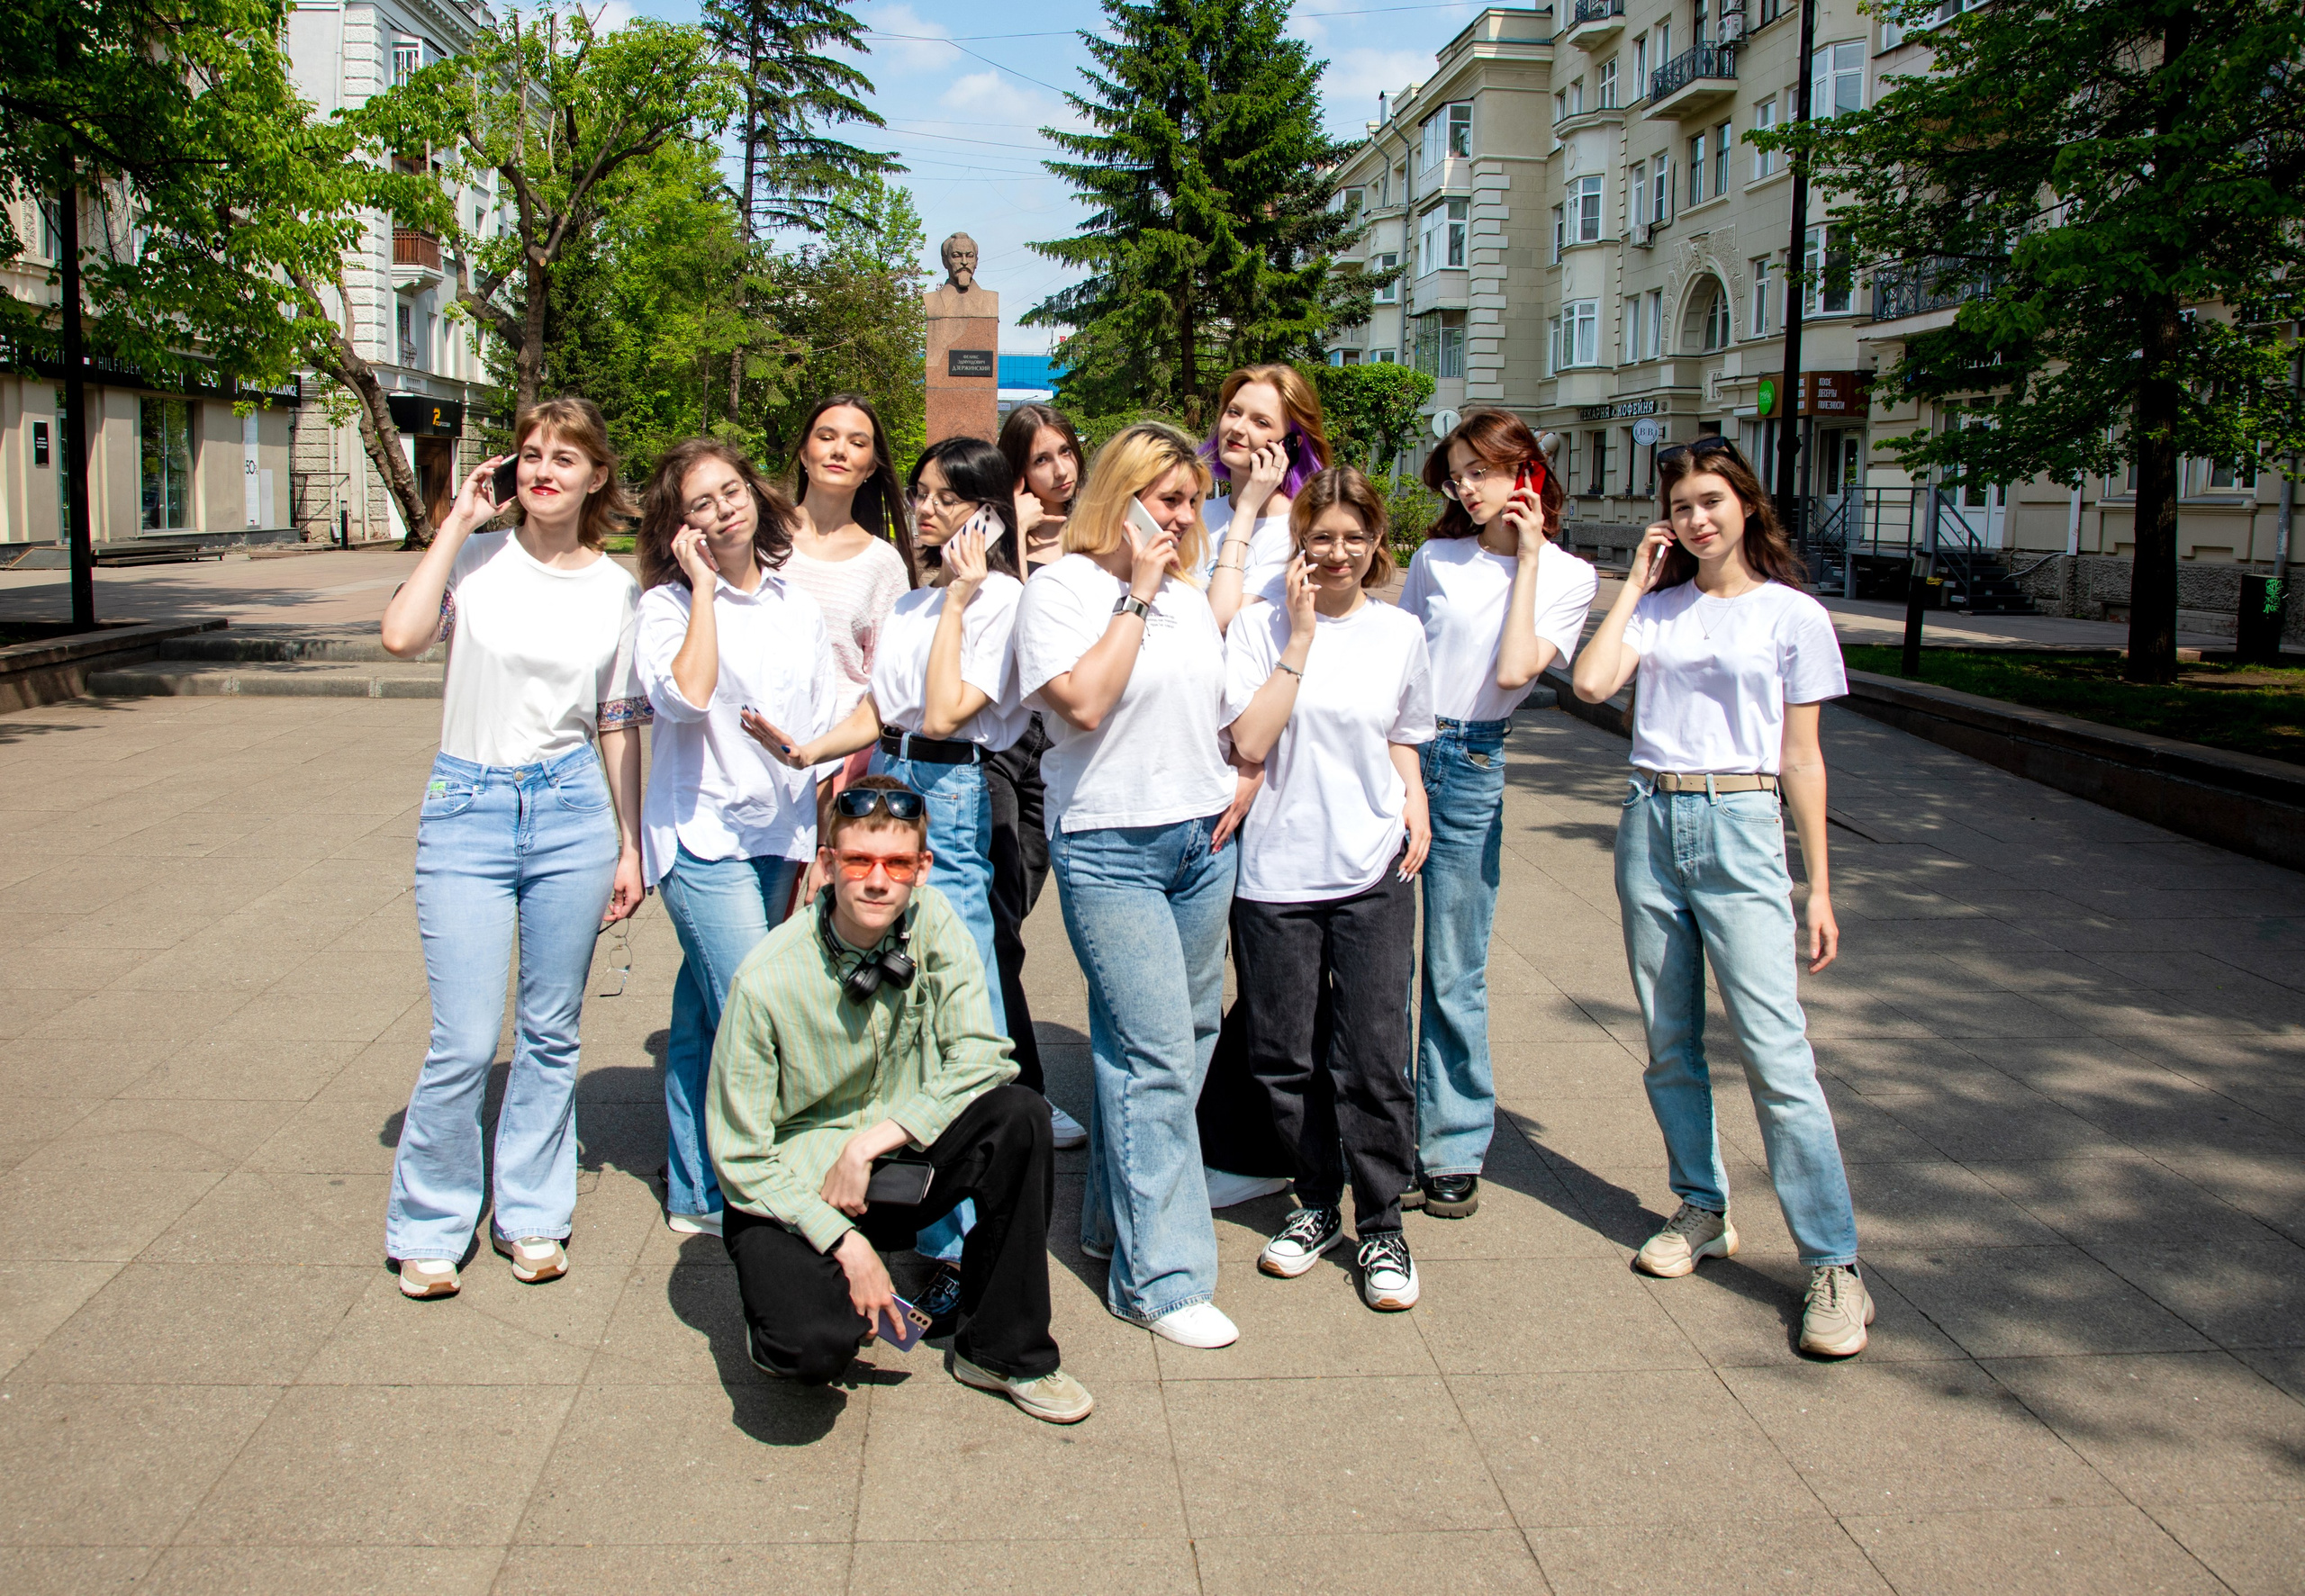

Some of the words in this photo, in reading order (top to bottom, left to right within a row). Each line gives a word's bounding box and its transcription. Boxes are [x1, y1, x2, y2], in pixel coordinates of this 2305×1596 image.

[1819, 378, 1832, 386] КОФЕ
[1817, 389, 1837, 397] ДЕСЕРТЫ
[1579, 406, 1610, 420] ПЕКАРНЯ
[1617, 400, 1655, 418] КОФЕЙНЯ
